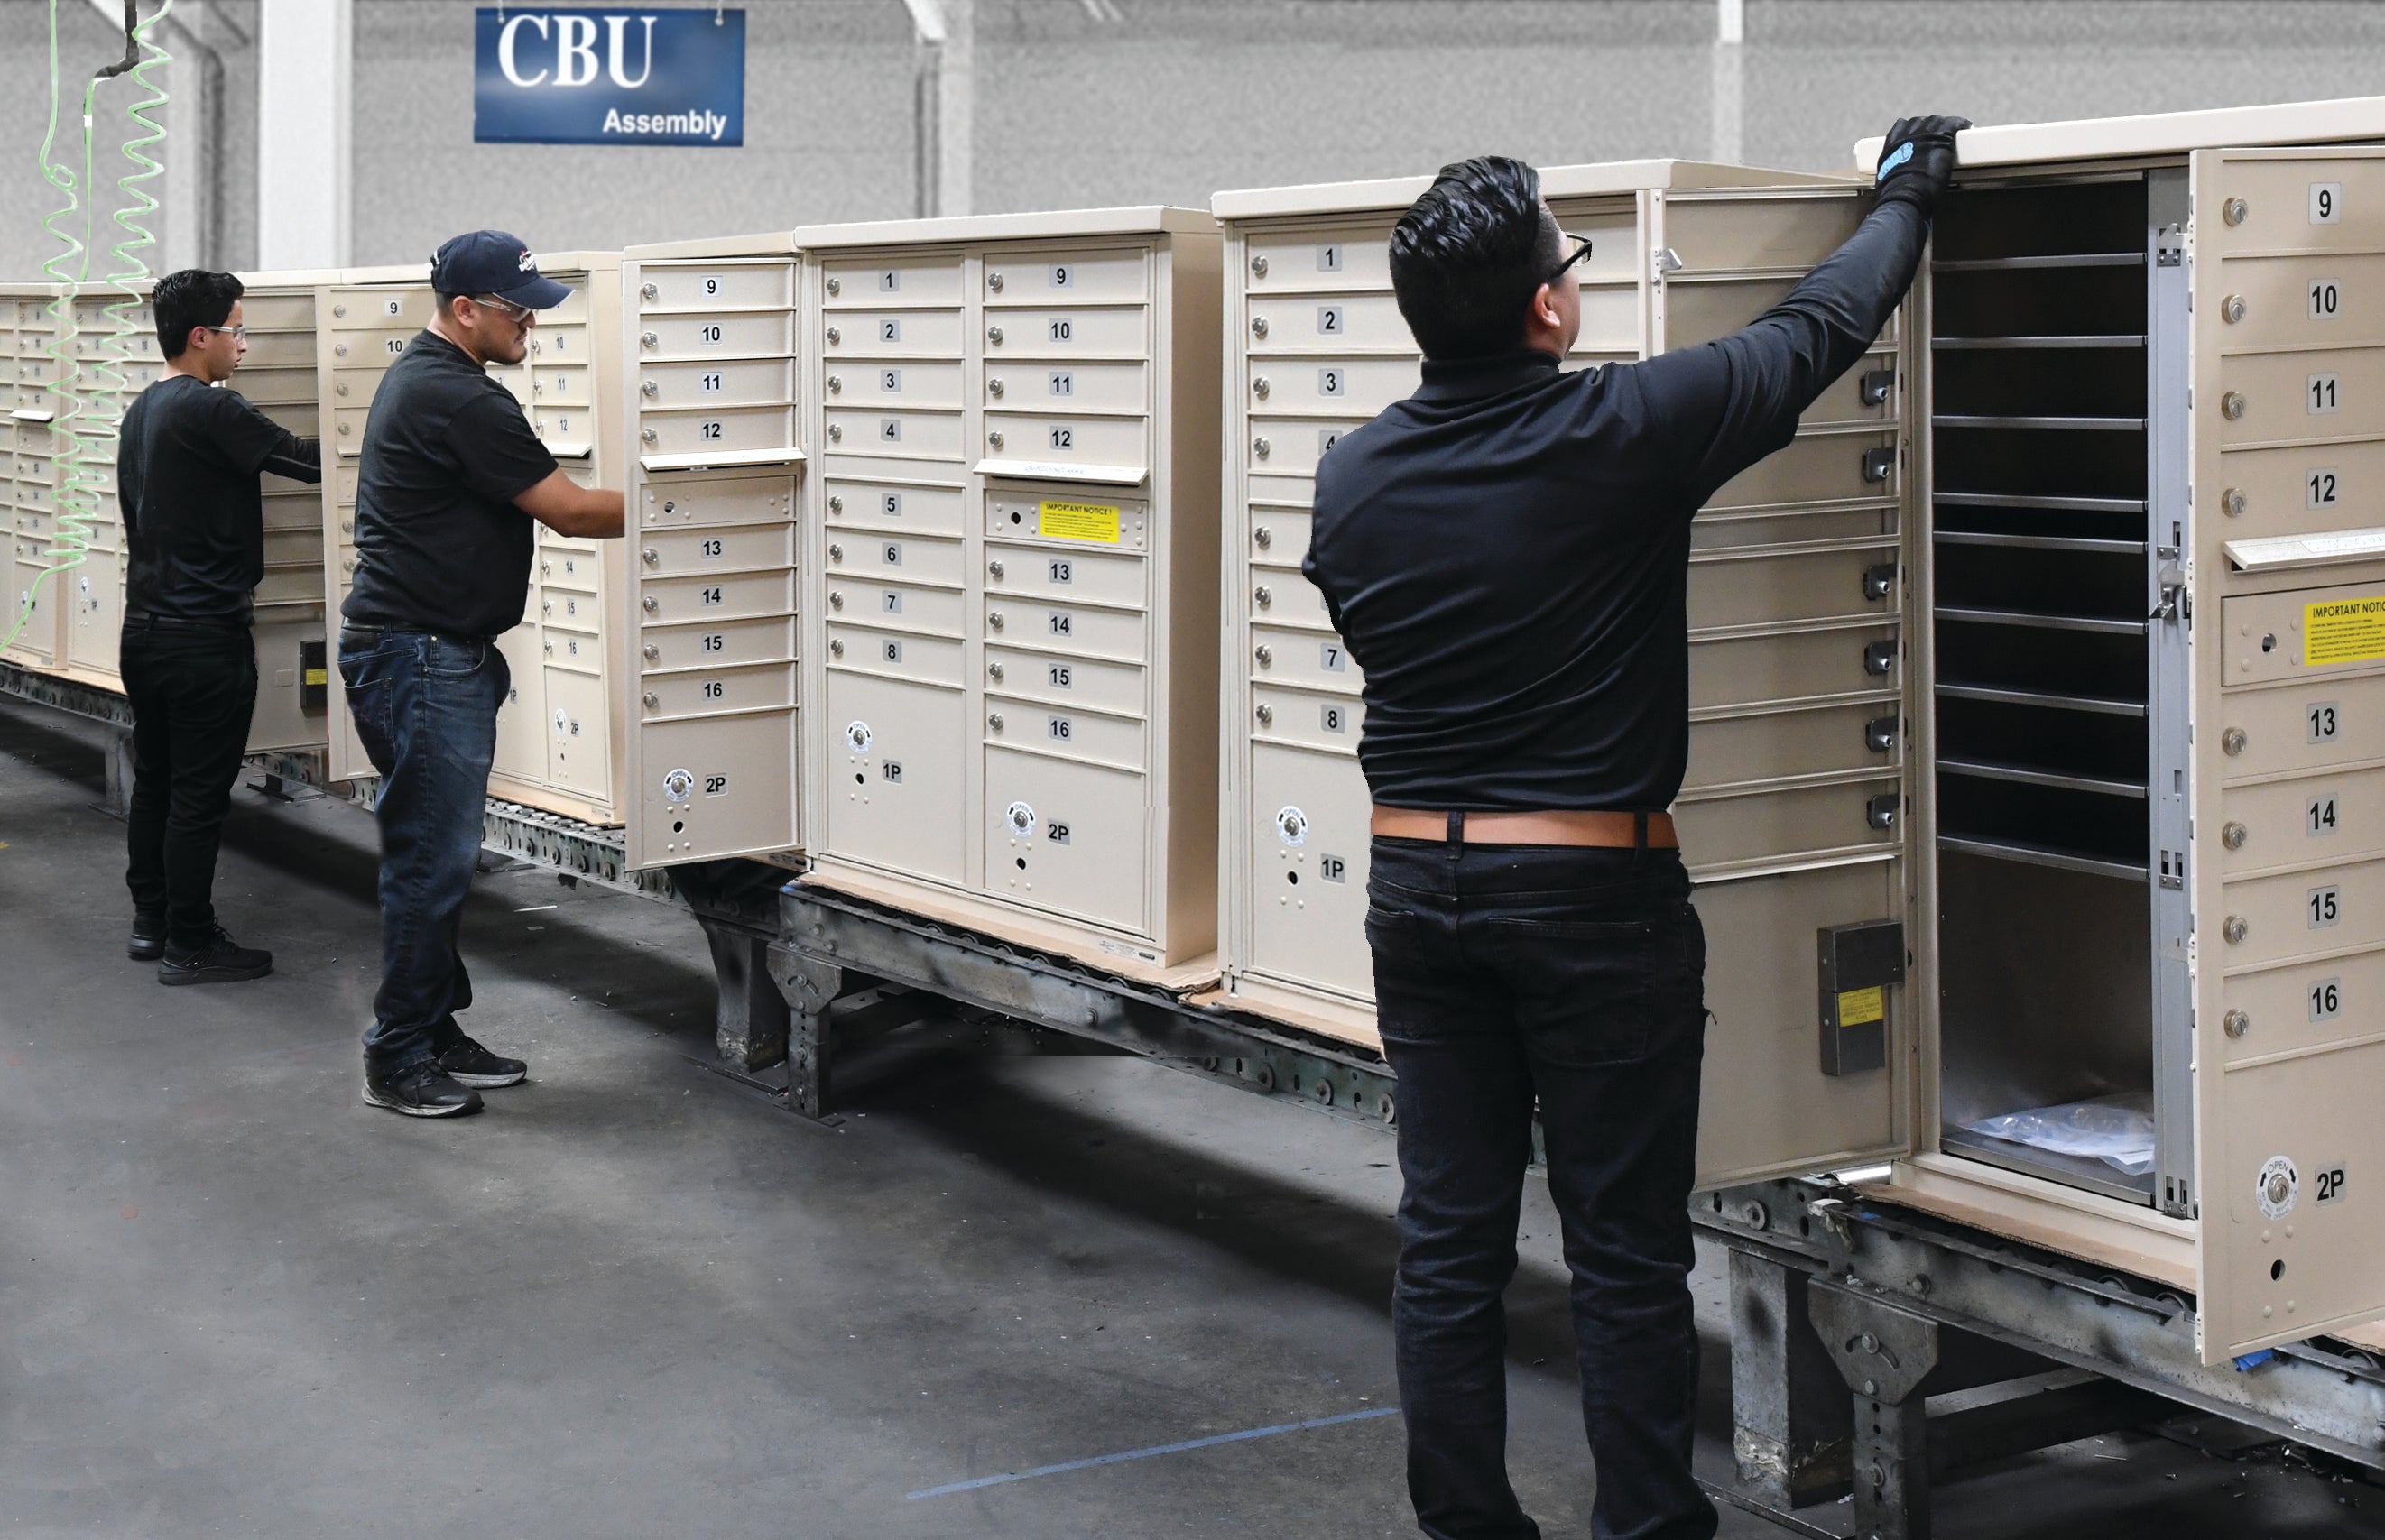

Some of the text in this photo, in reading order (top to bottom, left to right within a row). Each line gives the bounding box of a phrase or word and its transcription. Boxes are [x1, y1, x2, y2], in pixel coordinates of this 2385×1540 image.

[498, 14, 658, 88] CBU
[602, 108, 727, 141] Assembly
[2318, 189, 2332, 218] 9
[1325, 247, 1334, 267] 1
[885, 272, 892, 289] 1
[1056, 267, 1067, 285] 9
[707, 279, 716, 294] 9
[390, 301, 398, 315] 9
[2312, 285, 2337, 314] 10
[1325, 310, 1336, 330] 2
[702, 326, 721, 342] 10
[885, 323, 894, 339] 2
[1051, 322, 1070, 339] 10
[387, 340, 403, 353] 10
[556, 337, 564, 350] 10
[558, 378, 566, 391] 11
[703, 374, 720, 391] 11
[886, 373, 895, 389] 3
[1052, 376, 1069, 393] 11
[1326, 373, 1336, 392] 3
[2312, 379, 2335, 409] 11
[559, 418, 568, 431] 12
[702, 422, 721, 438] 12
[886, 423, 895, 438] 4
[1052, 429, 1071, 447] 12
[2310, 474, 2335, 503] 12
[887, 497, 896, 512] 5
[1046, 503, 1082, 512] IMPORTANT
[703, 540, 722, 556] 13
[887, 546, 896, 562] 6
[566, 560, 574, 574] 14
[1050, 563, 1070, 581] 13
[702, 587, 721, 604] 14
[887, 595, 896, 610] 7
[567, 601, 576, 614] 15
[2313, 604, 2360, 618] IMPORTANT
[1050, 615, 1070, 633] 14
[569, 641, 577, 655] 16
[703, 635, 722, 651] 15
[887, 643, 896, 659] 8
[1327, 649, 1337, 667] 7
[1050, 668, 1069, 686] 15
[704, 682, 723, 698] 16
[1327, 710, 1338, 729] 8
[2310, 707, 2335, 737] 13
[1050, 720, 1069, 738] 16
[883, 762, 901, 779] 1P
[706, 777, 726, 793] 2P
[2309, 799, 2336, 831] 14
[1048, 823, 1069, 841] 2P
[1322, 858, 1344, 878] 1P
[2311, 891, 2337, 922] 15
[2312, 984, 2338, 1015] 16
[2268, 1160, 2289, 1174] OPEN
[2316, 1169, 2345, 1202] 2P
